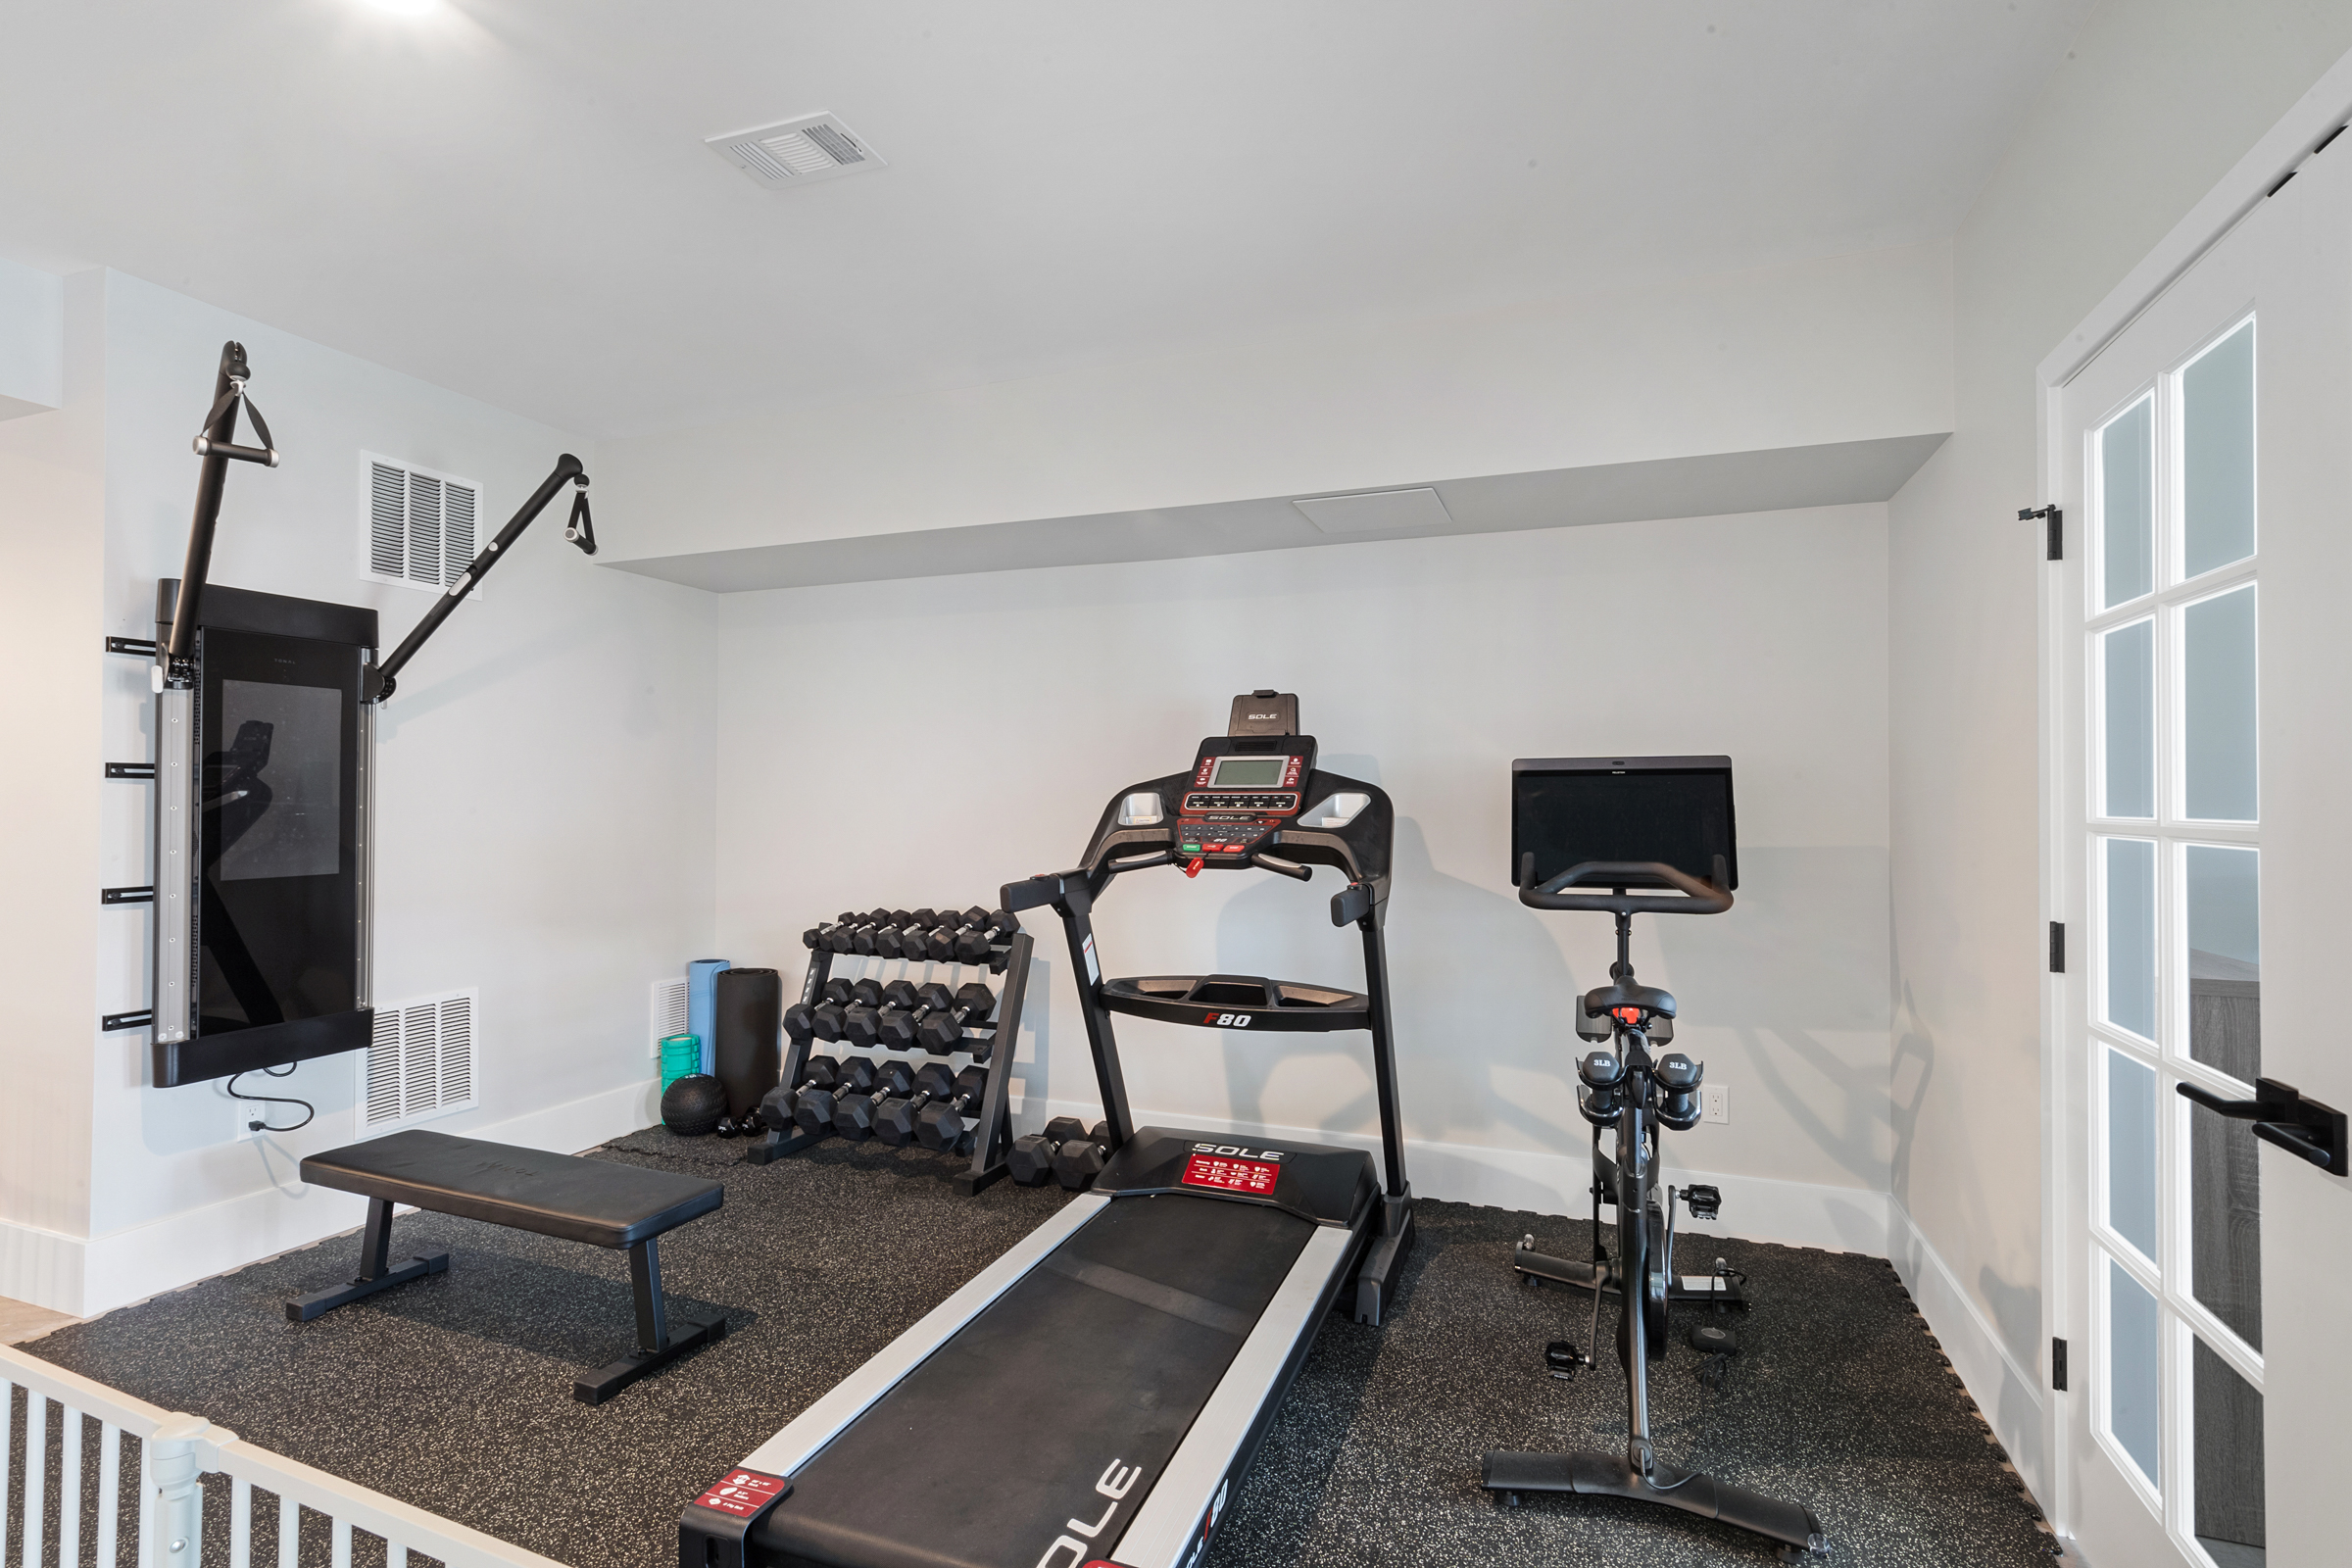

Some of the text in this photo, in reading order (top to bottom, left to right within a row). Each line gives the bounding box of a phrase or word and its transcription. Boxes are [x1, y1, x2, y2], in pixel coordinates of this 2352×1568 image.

[1202, 1011, 1251, 1027] F80
[1593, 1058, 1611, 1067] 3LB
[1669, 1061, 1688, 1070] 3LB
[1192, 1143, 1284, 1161] SOLE
[1036, 1458, 1142, 1568] OLE
[1186, 1478, 1229, 1568] OLE F80
